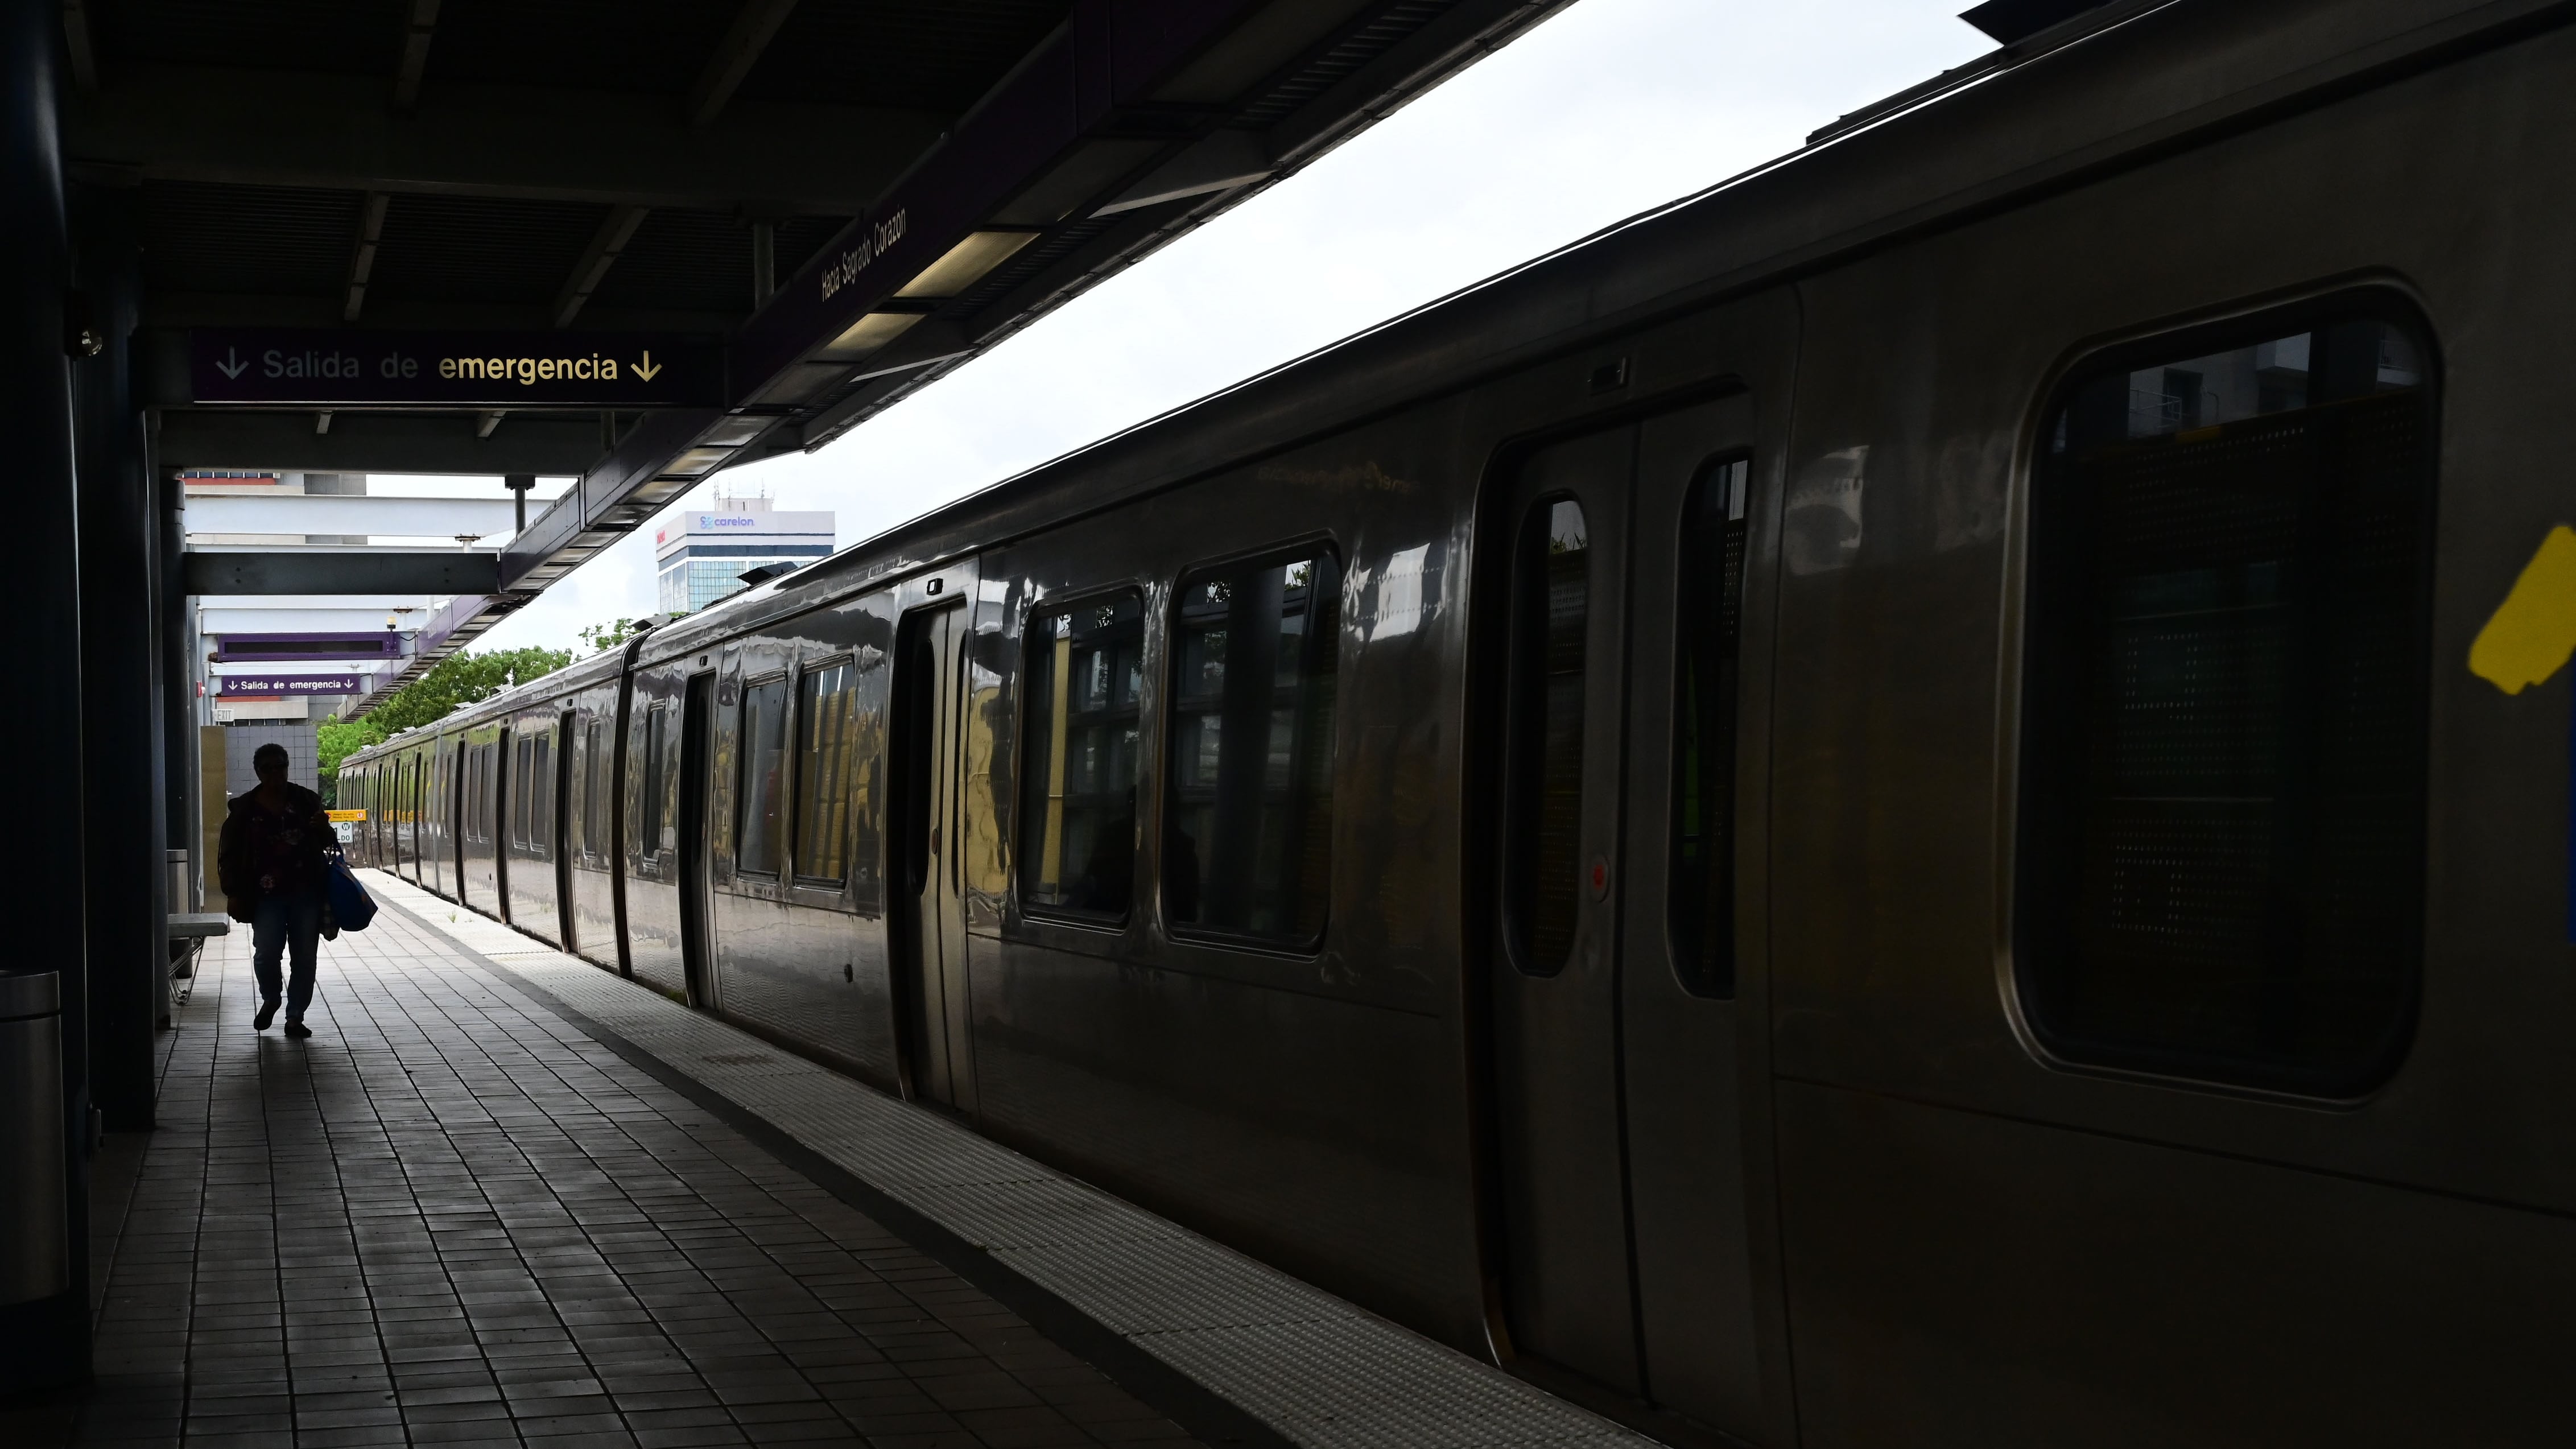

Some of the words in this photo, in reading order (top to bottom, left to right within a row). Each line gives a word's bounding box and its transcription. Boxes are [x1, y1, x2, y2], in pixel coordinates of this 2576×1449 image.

[822, 261, 840, 302] Hacia
[843, 234, 871, 285] Sagrado
[874, 204, 906, 257] Corazón
[263, 349, 360, 378] Salida
[380, 350, 419, 379] de
[439, 353, 617, 385] emergencia
[715, 516, 754, 526] carelon
[241, 681, 268, 690] Salida
[290, 680, 341, 690] emergencia
[217, 710, 232, 720] EXIT
